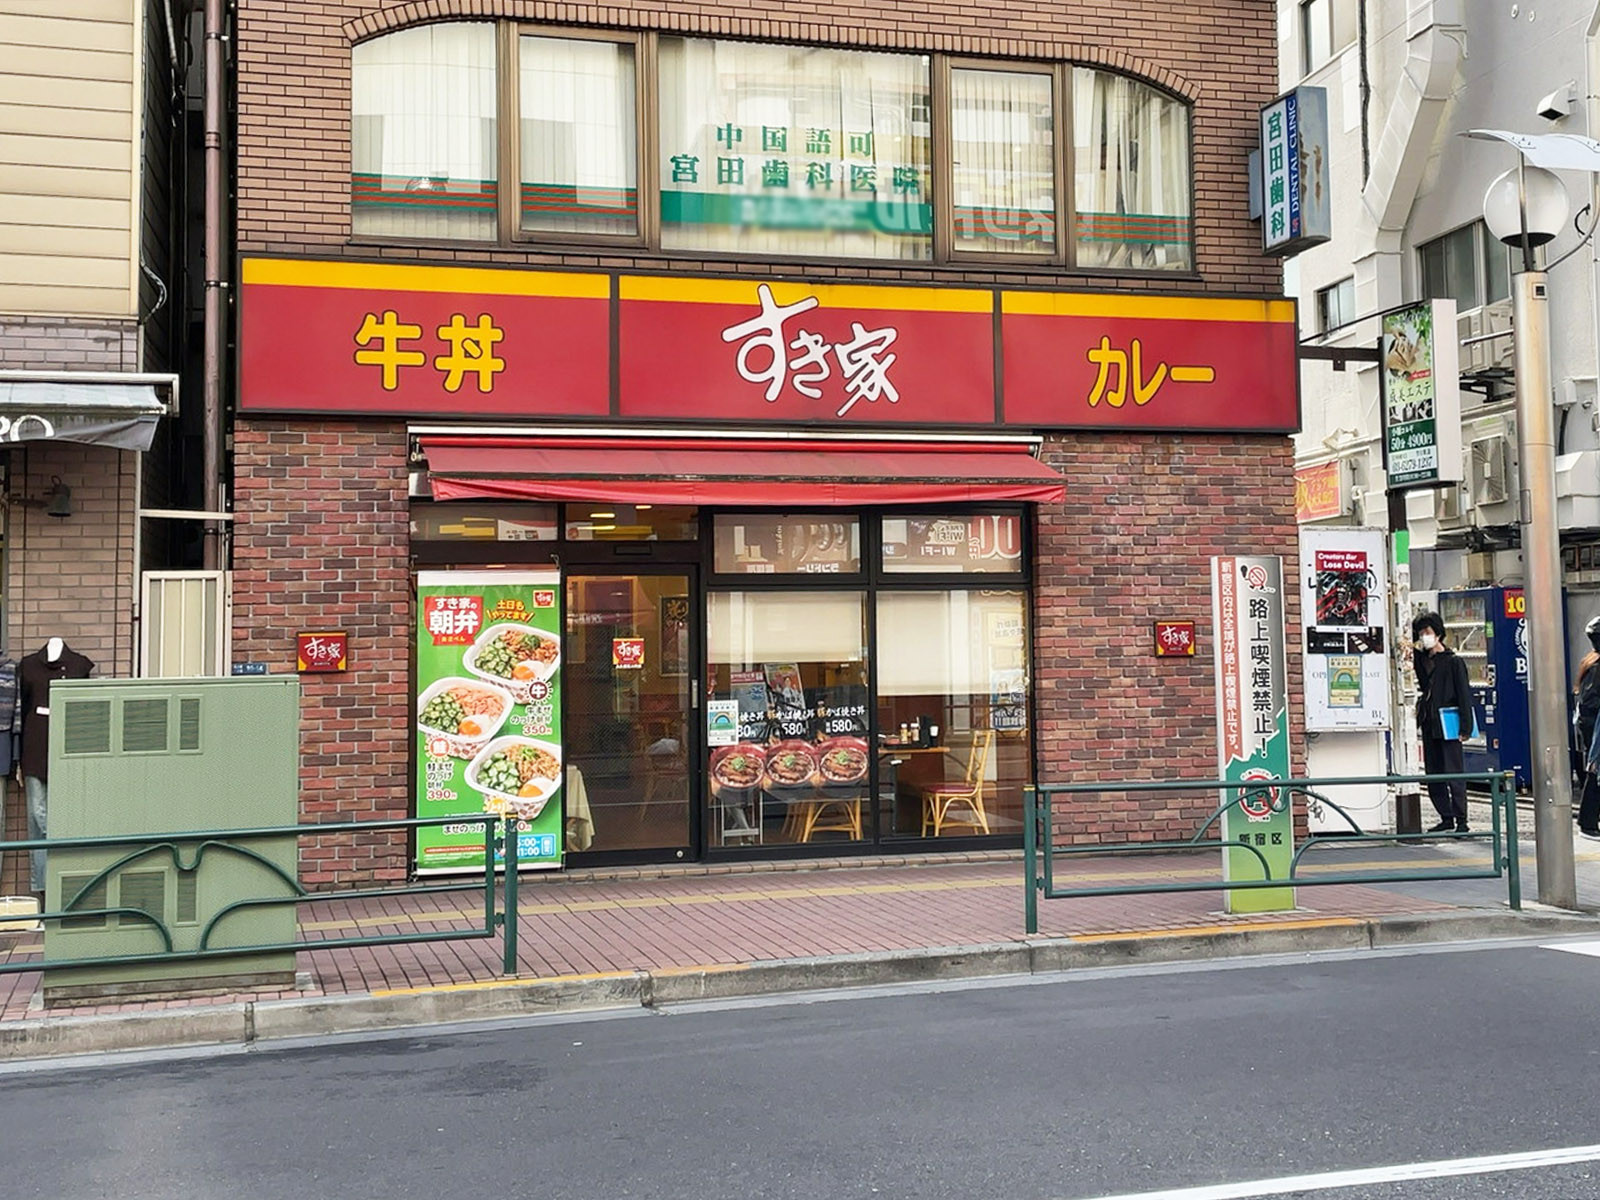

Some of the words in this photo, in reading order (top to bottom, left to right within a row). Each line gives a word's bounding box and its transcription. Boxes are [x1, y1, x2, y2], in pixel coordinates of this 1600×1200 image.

[717, 122, 874, 158] 中国語可
[1288, 99, 1297, 148] CLINIC
[670, 153, 921, 195] 宮田歯科医院
[1268, 111, 1285, 239] 宮田歯科
[1291, 151, 1299, 213] DENTAL
[353, 309, 506, 393] 牛丼
[722, 283, 899, 418] すき家
[1086, 335, 1216, 409] カレー
[1344, 561, 1365, 569] Devil
[429, 610, 479, 635] 朝弁
[434, 597, 477, 610] すき家の
[304, 637, 341, 662] すき家
[1161, 625, 1190, 647] すき家
[1239, 832, 1282, 846] 新宿区
